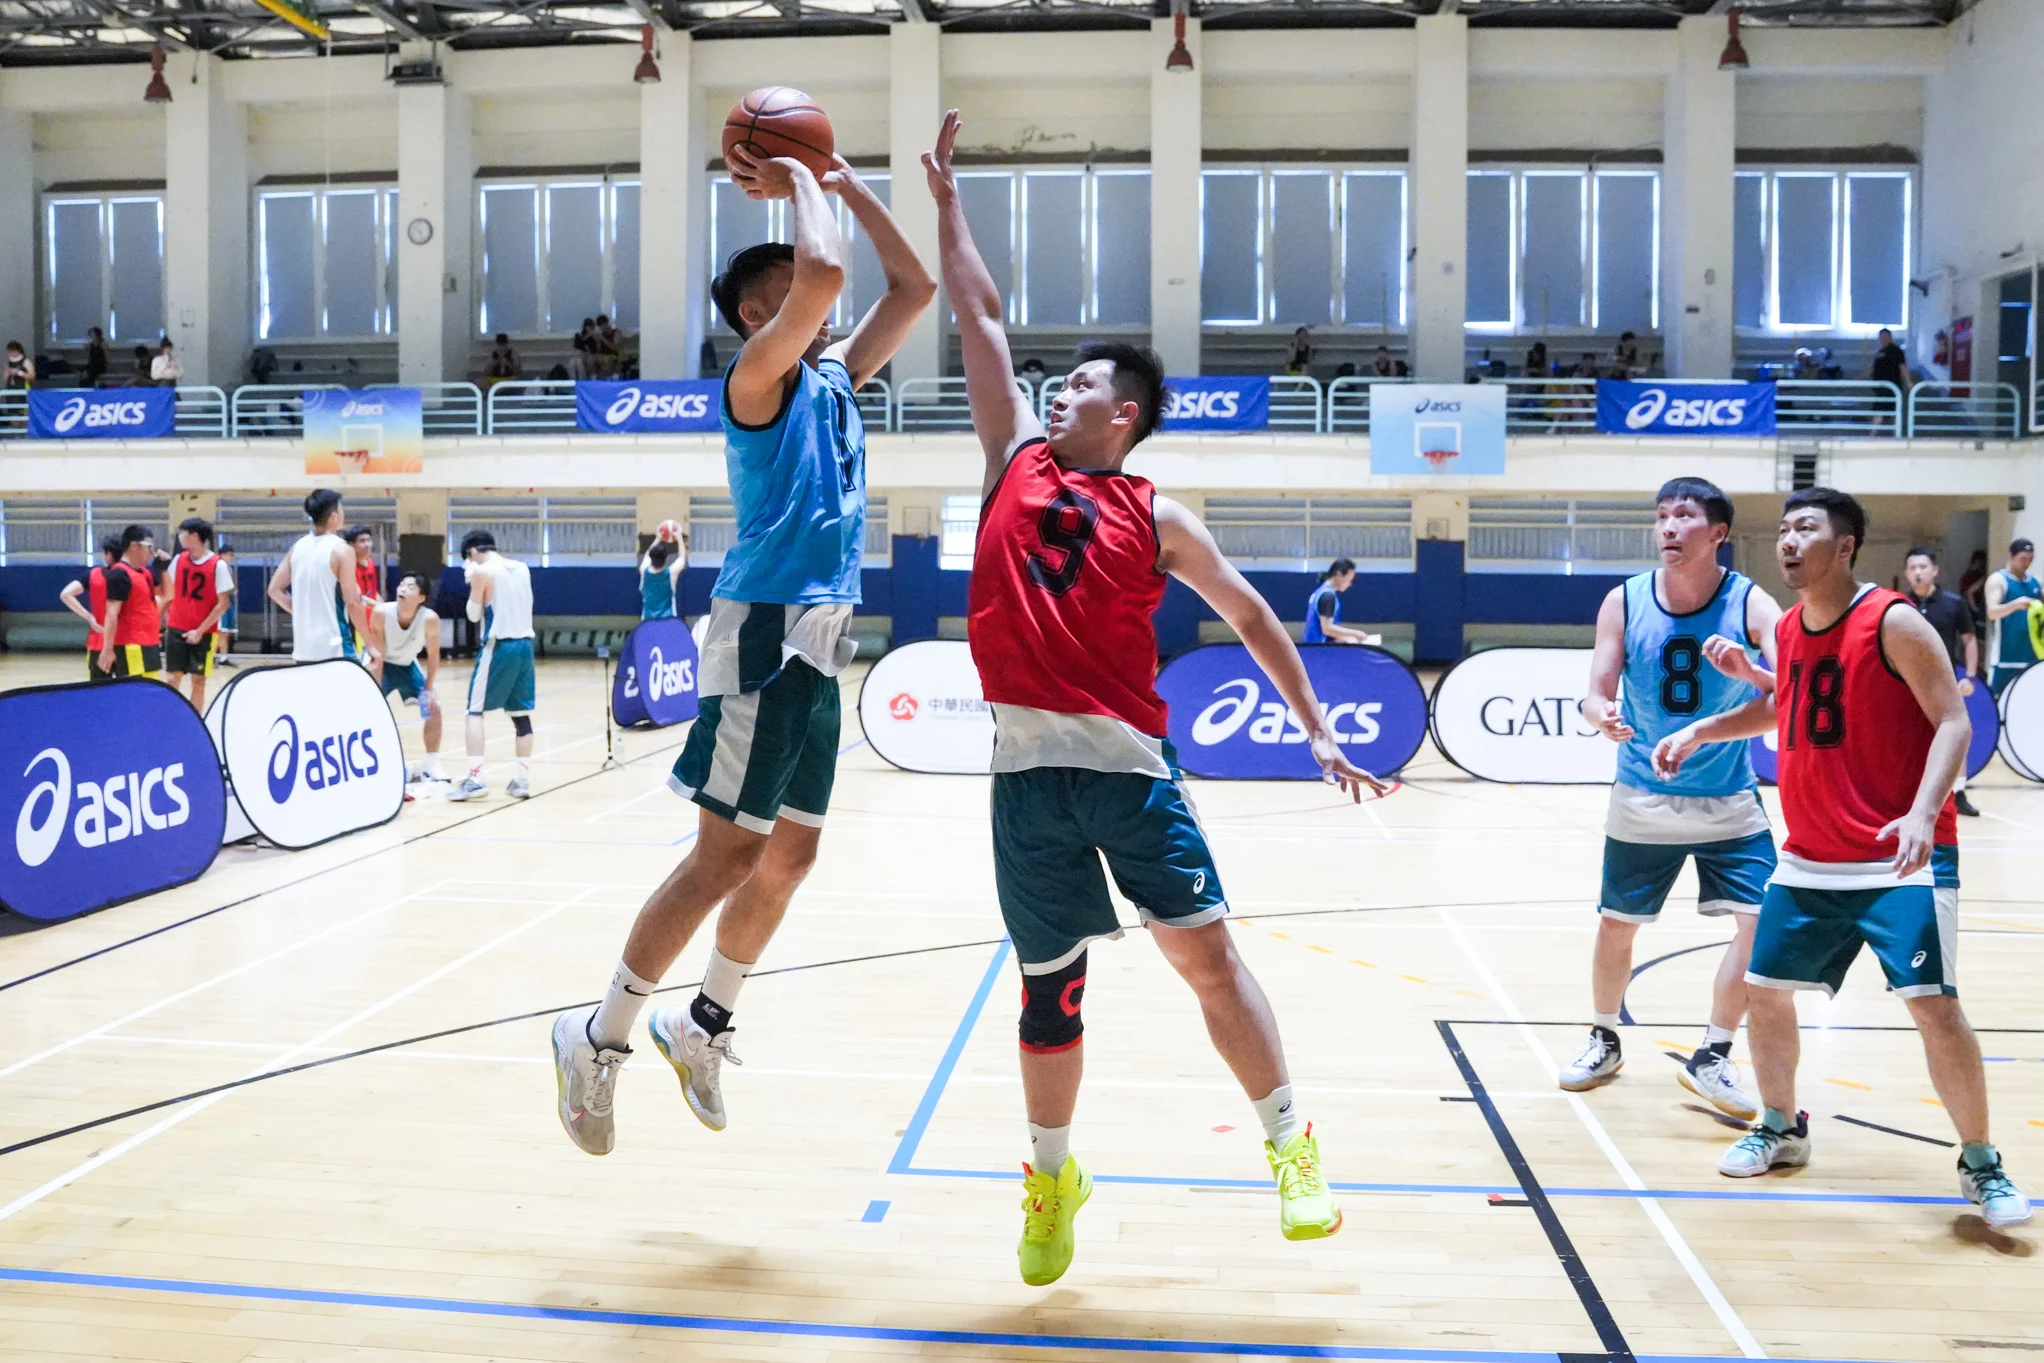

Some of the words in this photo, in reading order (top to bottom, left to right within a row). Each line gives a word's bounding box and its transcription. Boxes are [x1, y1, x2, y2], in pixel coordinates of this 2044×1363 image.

[84, 402, 147, 427] asics
[639, 394, 709, 418] asics
[1663, 399, 1746, 426] asics
[1025, 485, 1102, 598] 9
[182, 567, 206, 600] 12
[1660, 634, 1702, 717] 8
[1249, 702, 1382, 744] ascs
[1786, 655, 1846, 751] 18
[304, 728, 378, 790] asics
[74, 762, 190, 848] asics
